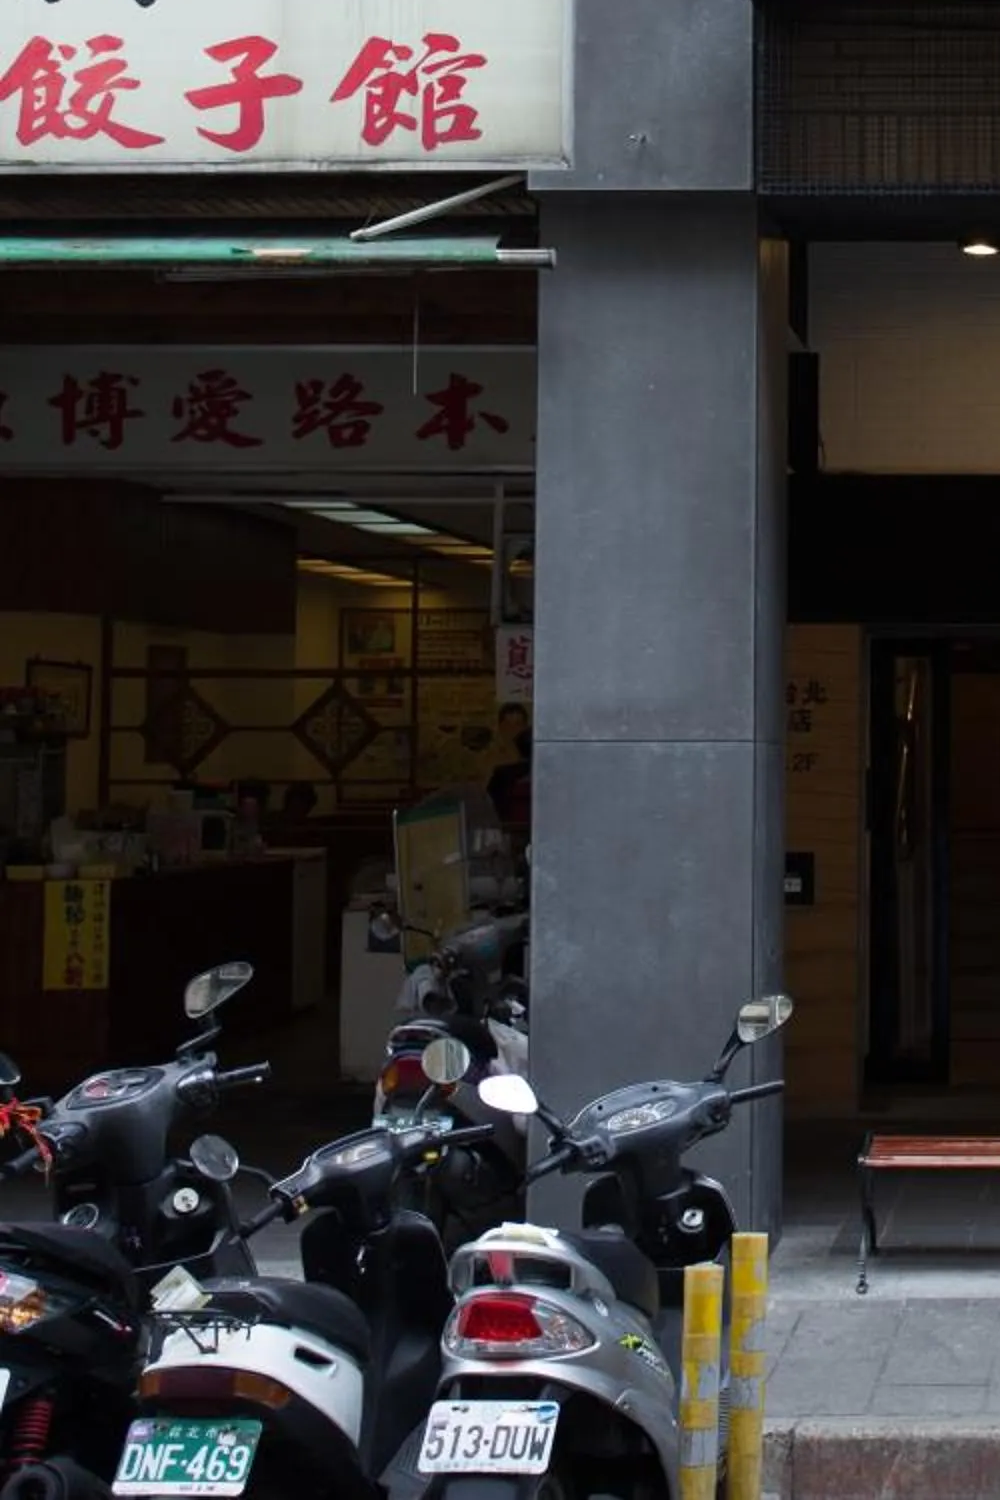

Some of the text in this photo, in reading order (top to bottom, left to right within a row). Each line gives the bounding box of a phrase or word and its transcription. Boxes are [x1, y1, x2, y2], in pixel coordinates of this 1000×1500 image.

[0, 33, 488, 152] 餃子館
[0, 369, 508, 450] 博愛路本
